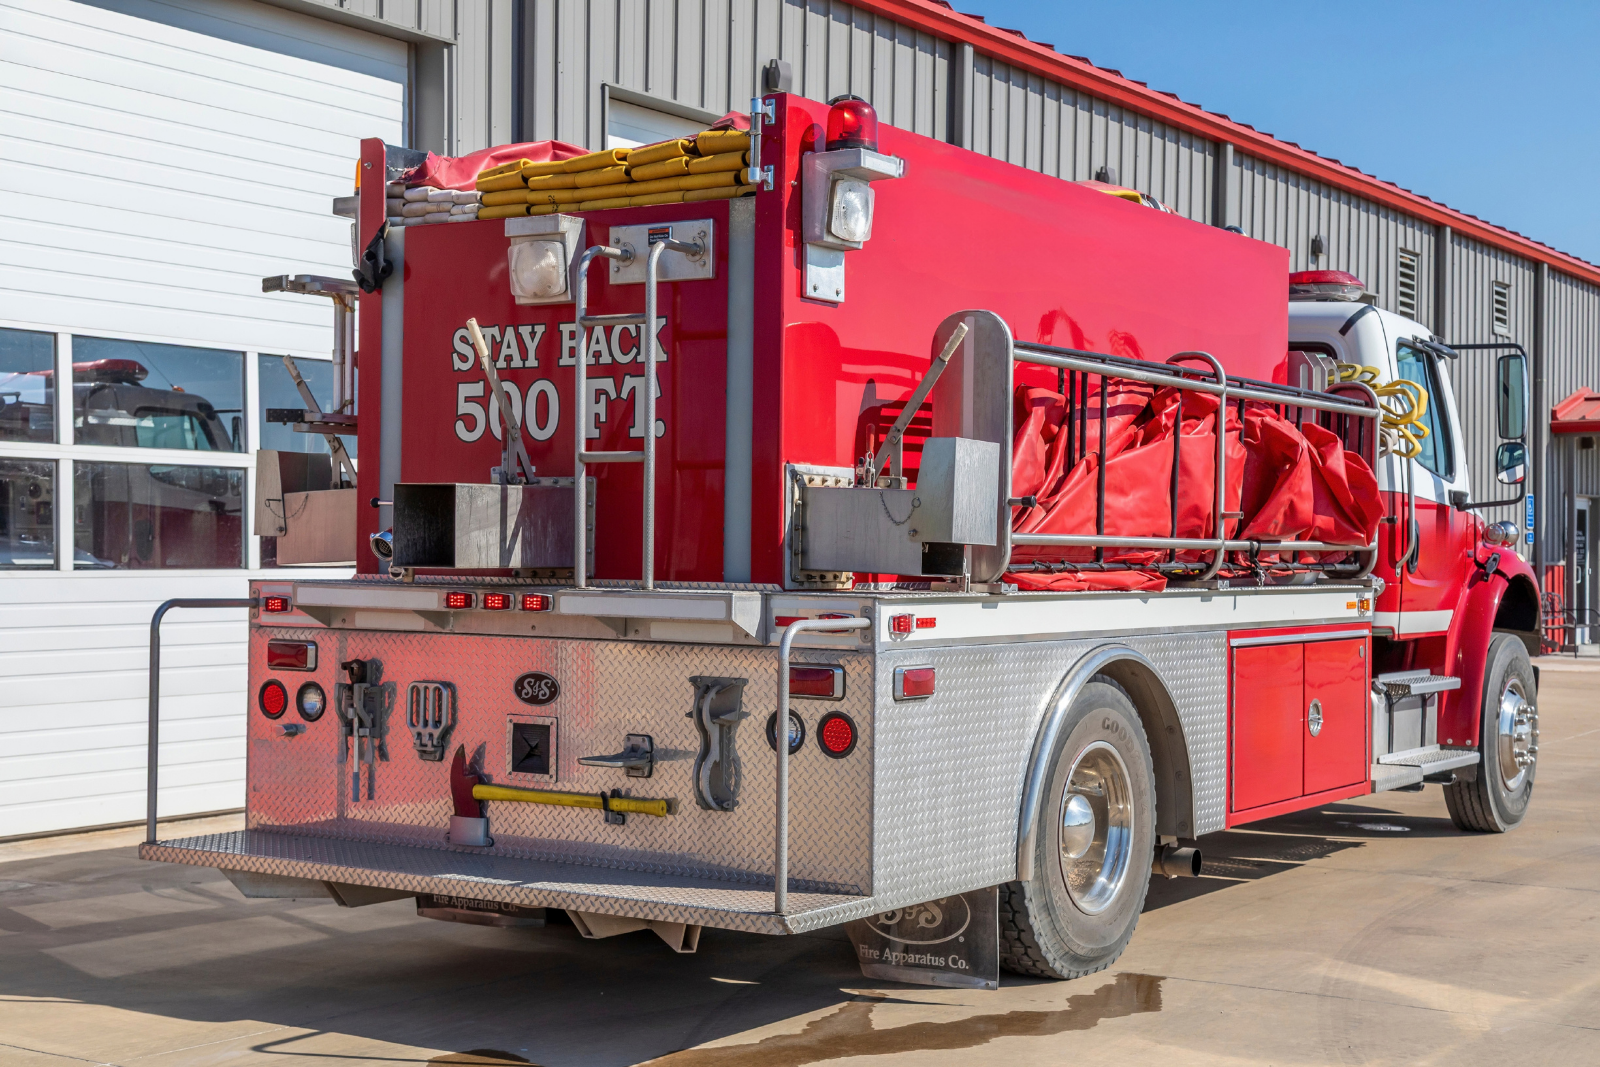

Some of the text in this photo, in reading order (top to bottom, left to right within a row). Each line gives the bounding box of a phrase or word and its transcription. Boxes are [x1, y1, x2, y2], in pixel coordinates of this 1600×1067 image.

[452, 316, 668, 372] STAY BACK
[454, 373, 667, 443] 500 FT.
[433, 893, 519, 912] Fire Apparatus Co.
[859, 945, 969, 970] Fire Apparatus Co.
